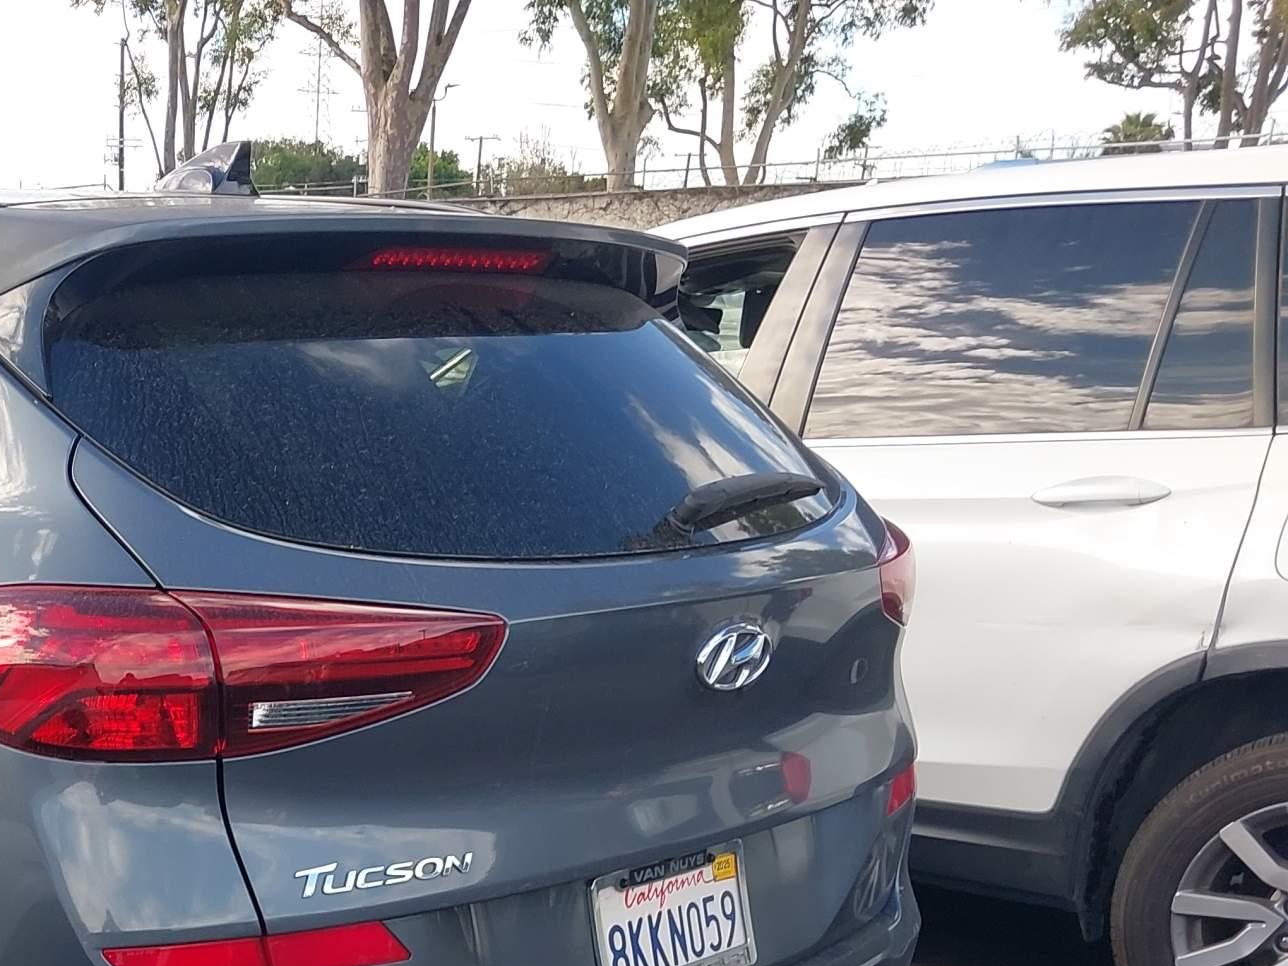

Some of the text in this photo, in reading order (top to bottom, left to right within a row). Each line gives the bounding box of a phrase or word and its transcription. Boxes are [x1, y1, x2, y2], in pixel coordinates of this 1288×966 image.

[633, 854, 705, 883] VAN NUYS
[623, 868, 712, 909] California
